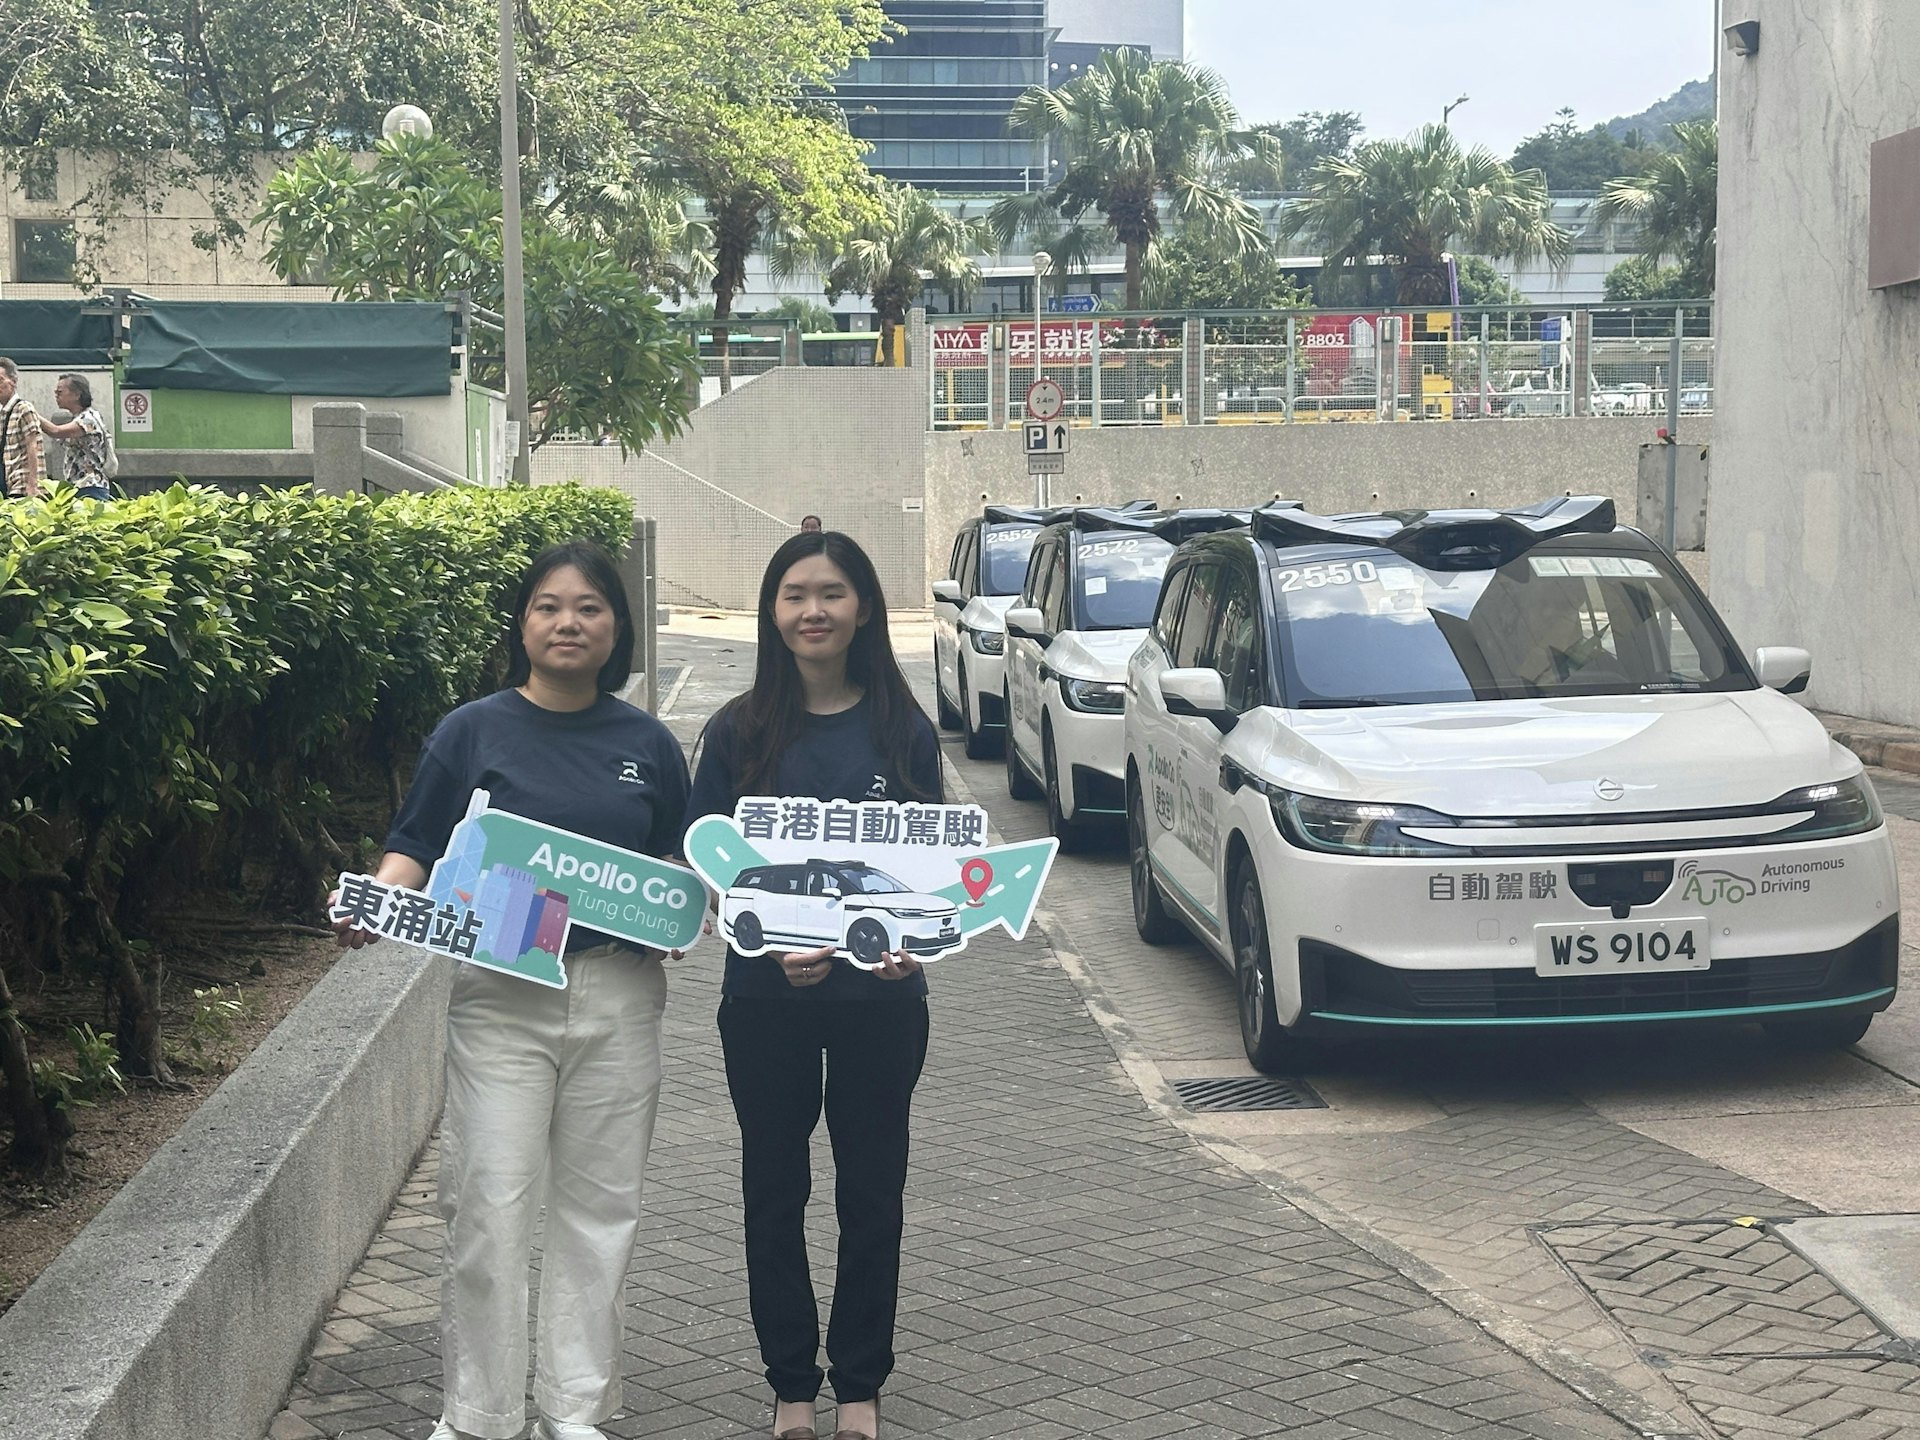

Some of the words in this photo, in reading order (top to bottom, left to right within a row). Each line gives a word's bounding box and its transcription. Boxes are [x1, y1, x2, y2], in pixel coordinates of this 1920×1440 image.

[1307, 333, 1345, 346] 8803
[1035, 397, 1055, 405] 2.4m
[1029, 426, 1044, 449] P
[986, 529, 1033, 544] 2552
[1078, 539, 1140, 560] 2572
[1278, 560, 1378, 593] 2550
[739, 801, 983, 848] 香港自動駕駛
[527, 842, 637, 895] Apollo
[642, 877, 688, 910] Go
[1761, 858, 1845, 877] Autonomous
[1429, 872, 1558, 901] 自動駕駛
[1761, 878, 1811, 895] Driving
[333, 877, 484, 959] 東涌站
[576, 888, 619, 920] Tung
[622, 904, 680, 939] Chung
[1550, 935, 1600, 966] WS
[1609, 930, 1697, 963] 9104
